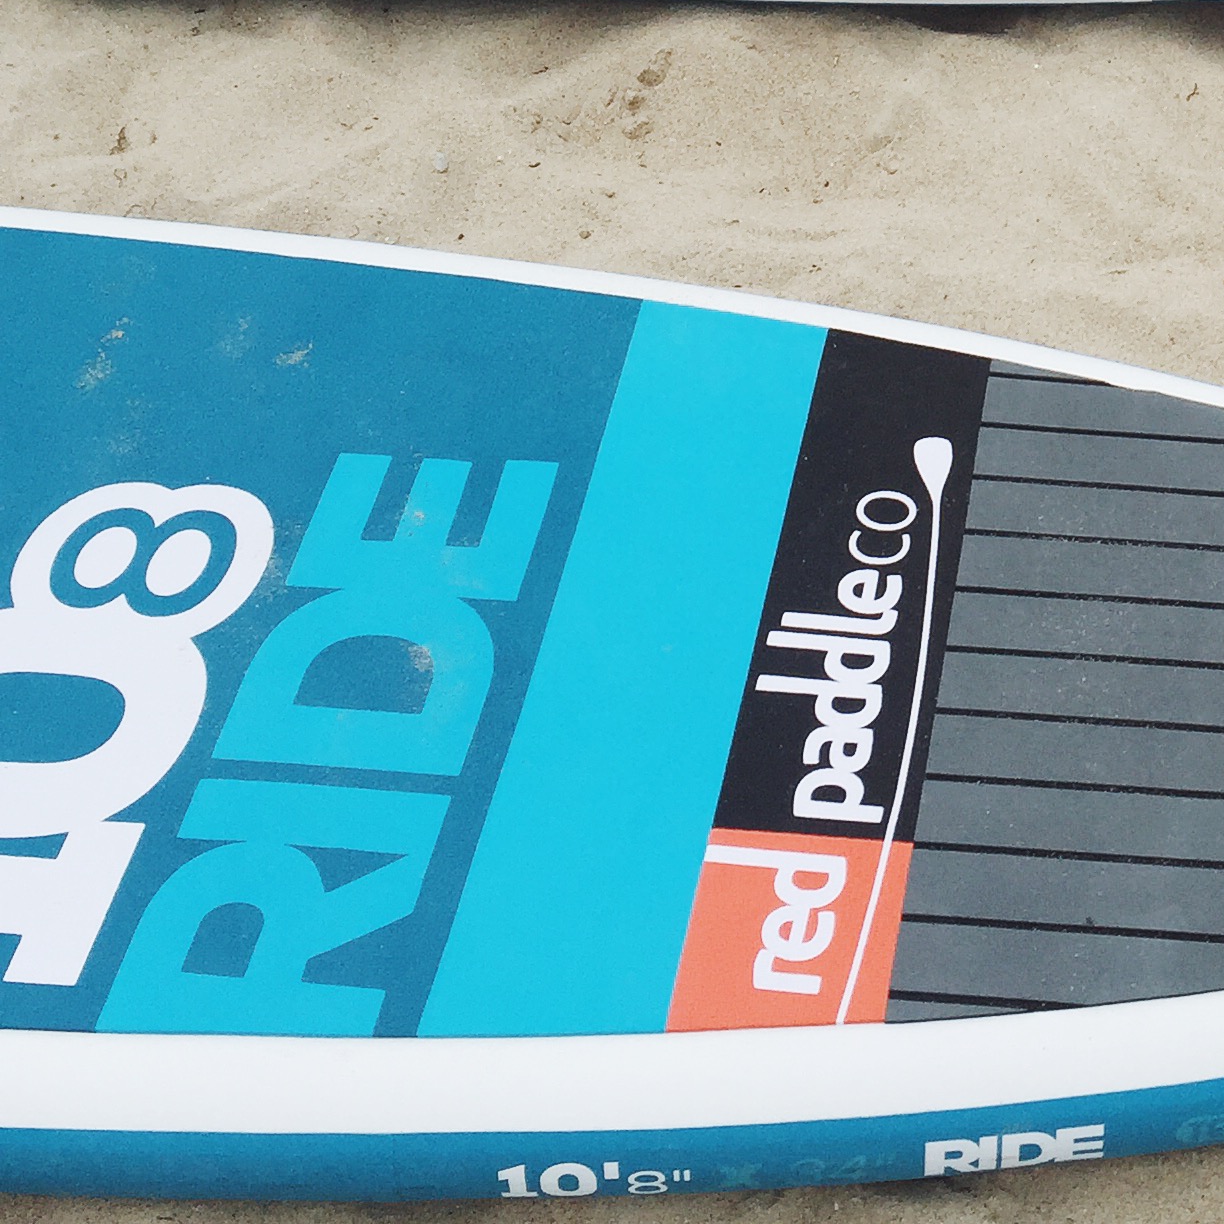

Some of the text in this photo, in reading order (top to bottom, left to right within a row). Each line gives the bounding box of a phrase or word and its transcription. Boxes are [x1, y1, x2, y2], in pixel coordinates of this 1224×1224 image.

[95, 452, 560, 1037] RIDE
[703, 844, 847, 996] red
[924, 1123, 1105, 1177] RIDE
